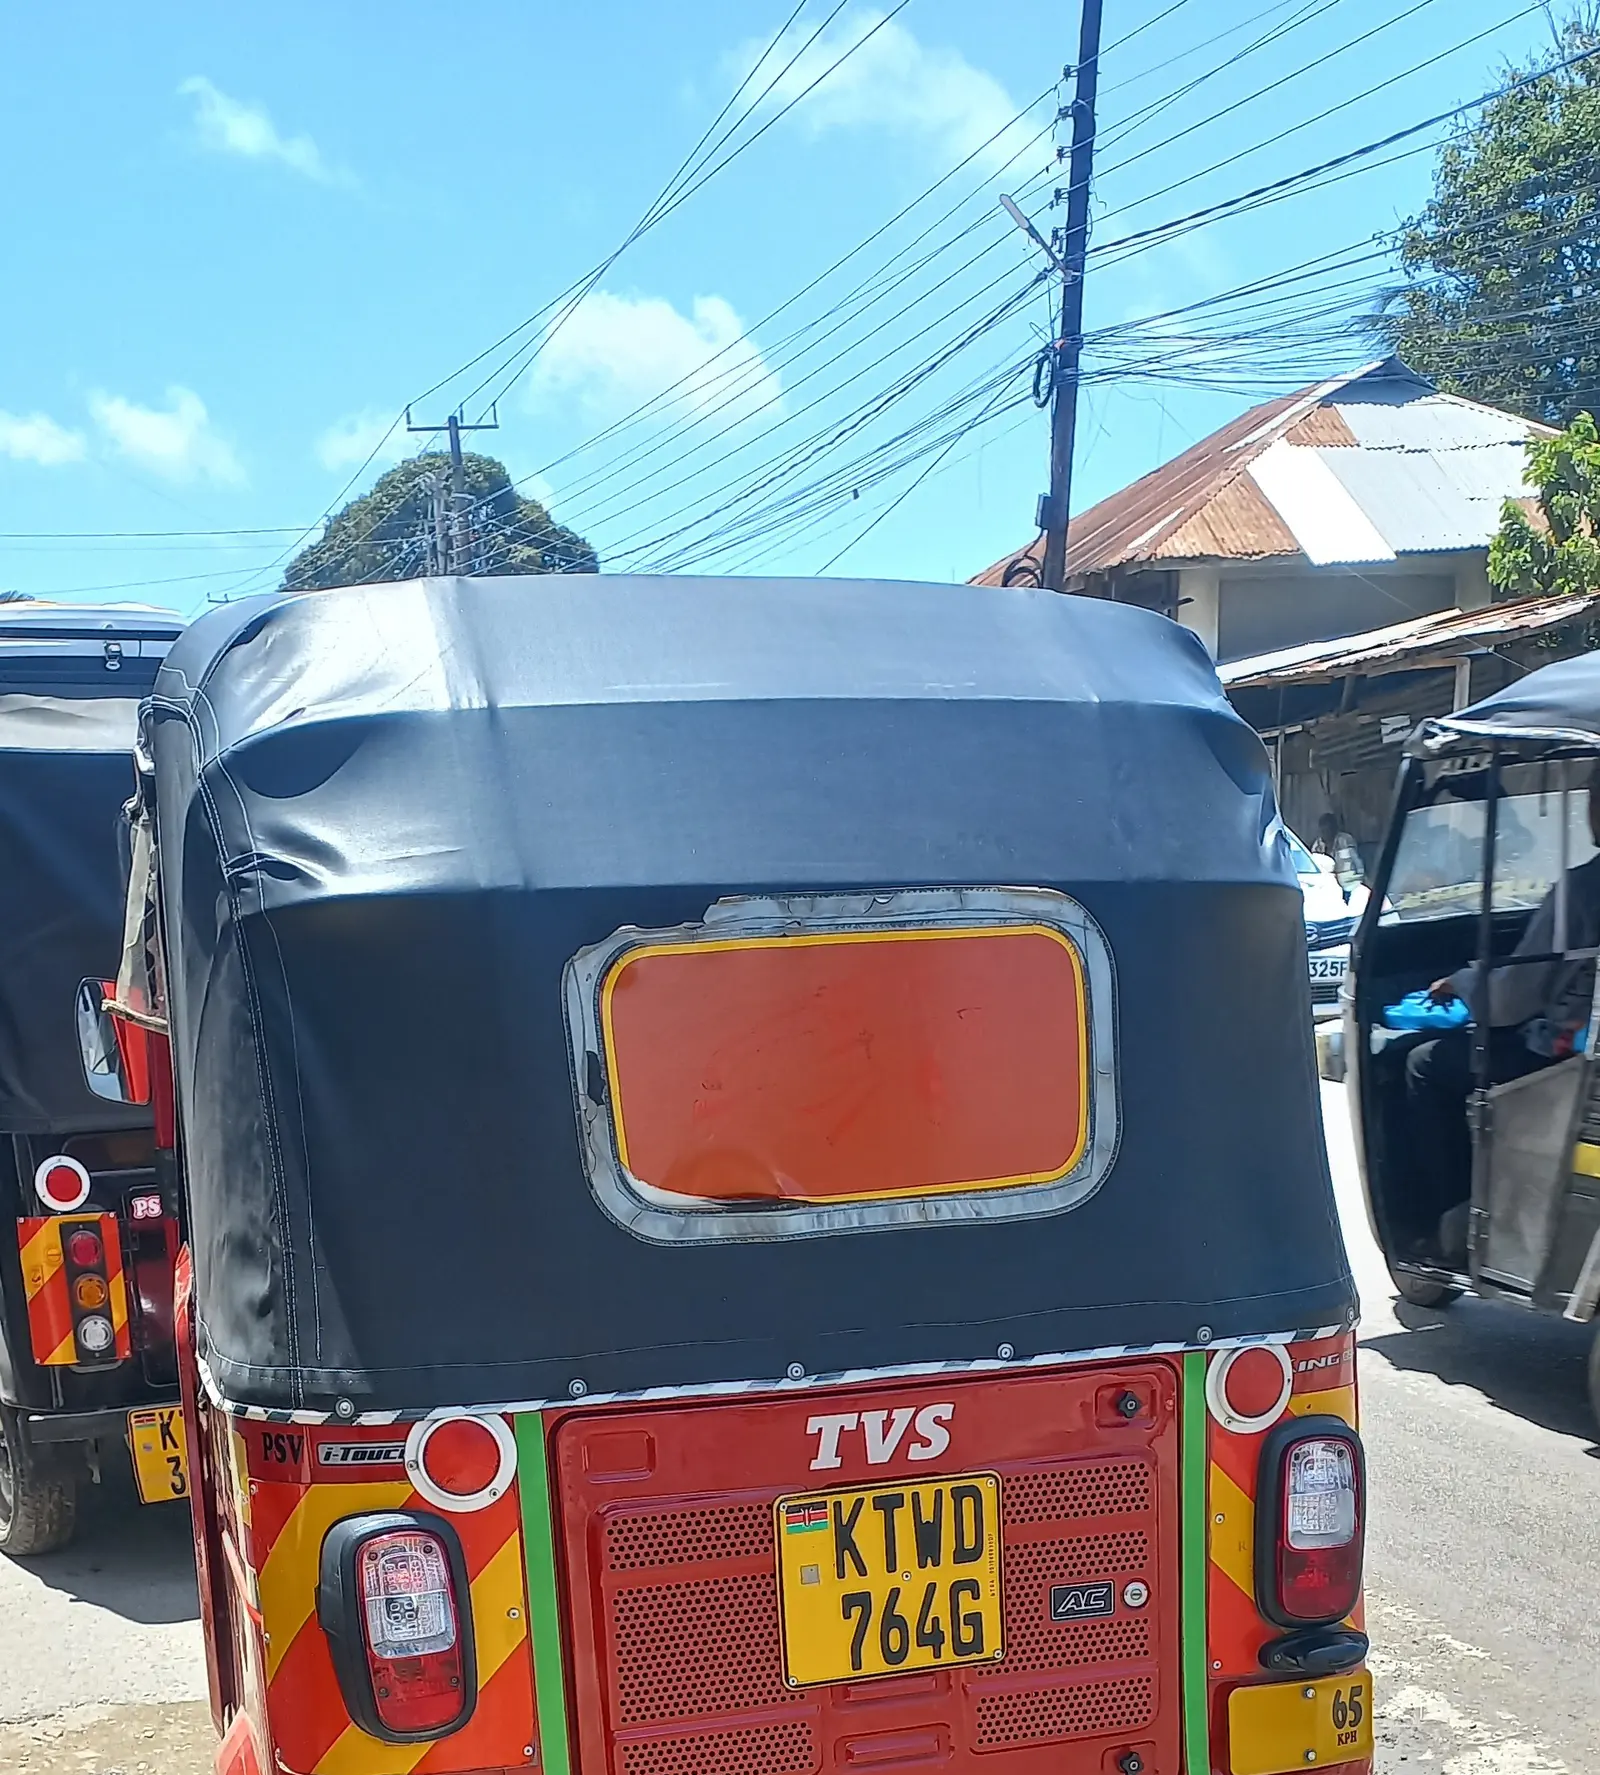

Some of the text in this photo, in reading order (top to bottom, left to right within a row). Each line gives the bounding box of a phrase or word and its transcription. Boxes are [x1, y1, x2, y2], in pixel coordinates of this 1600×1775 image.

[1291, 1353, 1340, 1374] ING
[159, 1409, 184, 1451] K
[262, 1432, 304, 1465] PSV
[806, 1402, 955, 1471] TVS
[832, 1484, 985, 1580] KTWD
[1056, 1587, 1109, 1613] AC
[841, 1578, 985, 1671] 764G
[1332, 1685, 1363, 1730] 65
[1337, 1729, 1358, 1747] KPH
